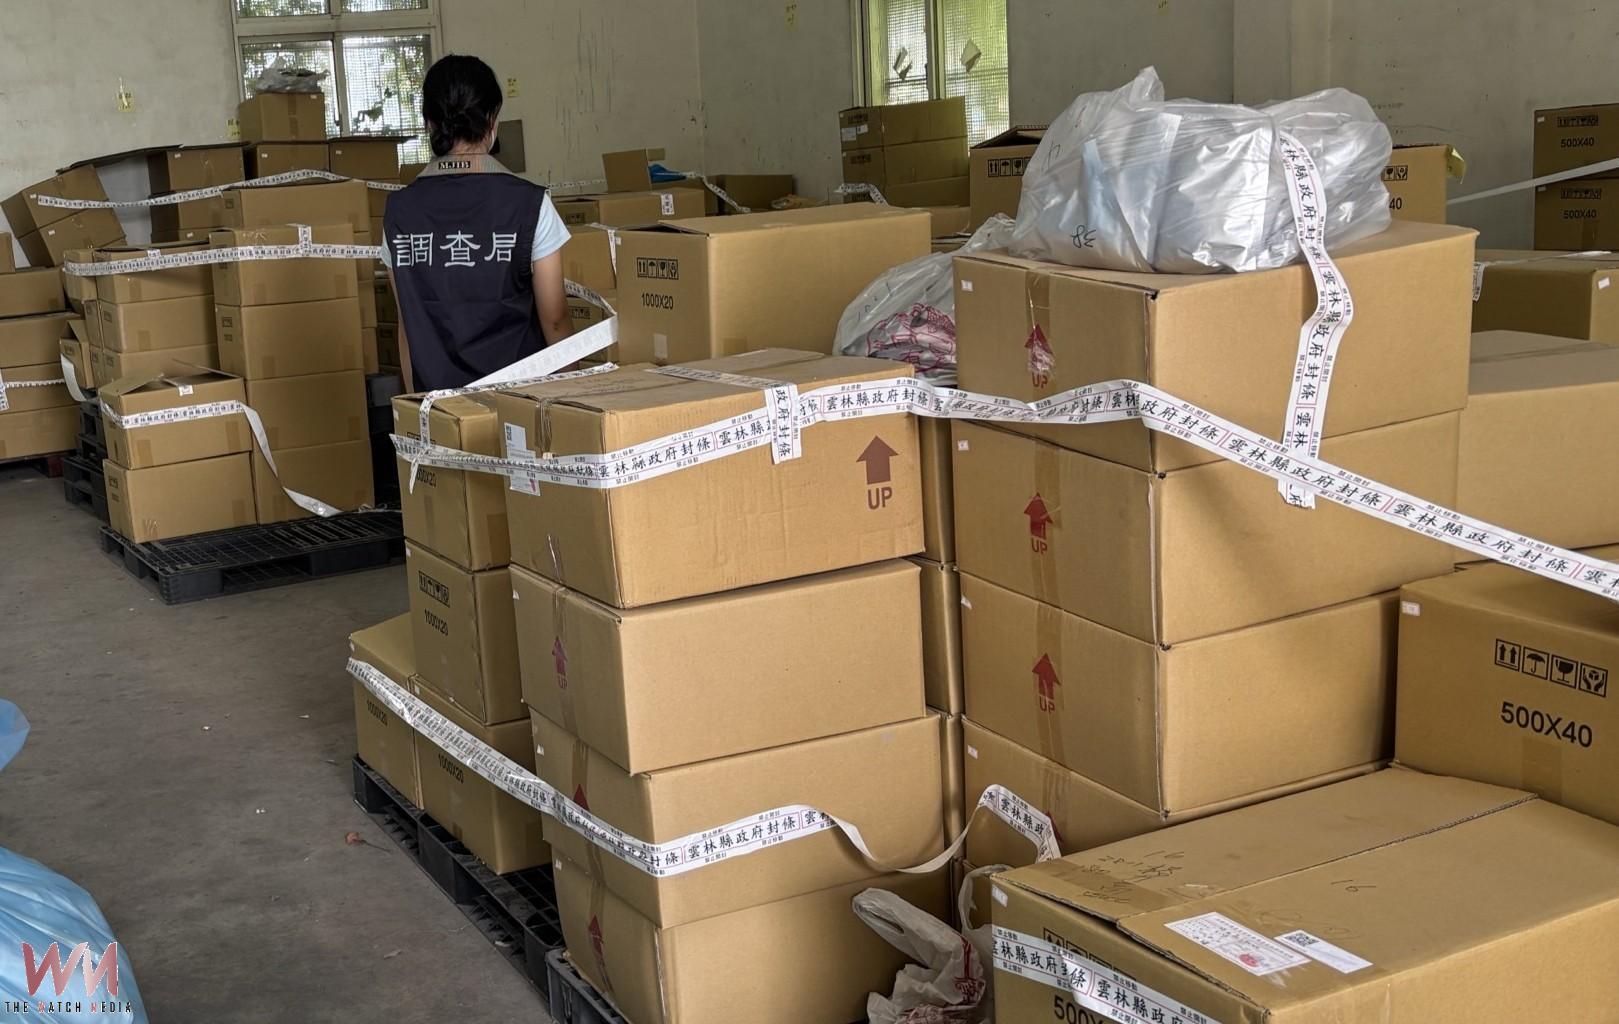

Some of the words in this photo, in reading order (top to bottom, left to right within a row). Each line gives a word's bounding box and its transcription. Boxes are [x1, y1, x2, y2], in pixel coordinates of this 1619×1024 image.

[1560, 137, 1595, 148] 500X40
[1563, 209, 1597, 220] 500X40
[392, 230, 517, 268] 調查局
[641, 292, 674, 310] 1000X20
[826, 389, 929, 411] 雲林縣政府封條
[1111, 390, 1221, 440] 雲林政府封條
[775, 388, 791, 457] 政府封條
[1293, 412, 1311, 449] 雲林
[598, 436, 711, 479] 雲林縣政府封條
[1228, 437, 1382, 507] 雲林縣政府封條
[867, 486, 893, 510] UP
[1031, 537, 1048, 555] UP
[1392, 502, 1569, 573] 雲林縣政府封條
[424, 608, 449, 636] 1000X20
[1039, 696, 1056, 713] UP
[1501, 701, 1593, 748] 500X40
[688, 815, 797, 859] 雲林縣政府封條
